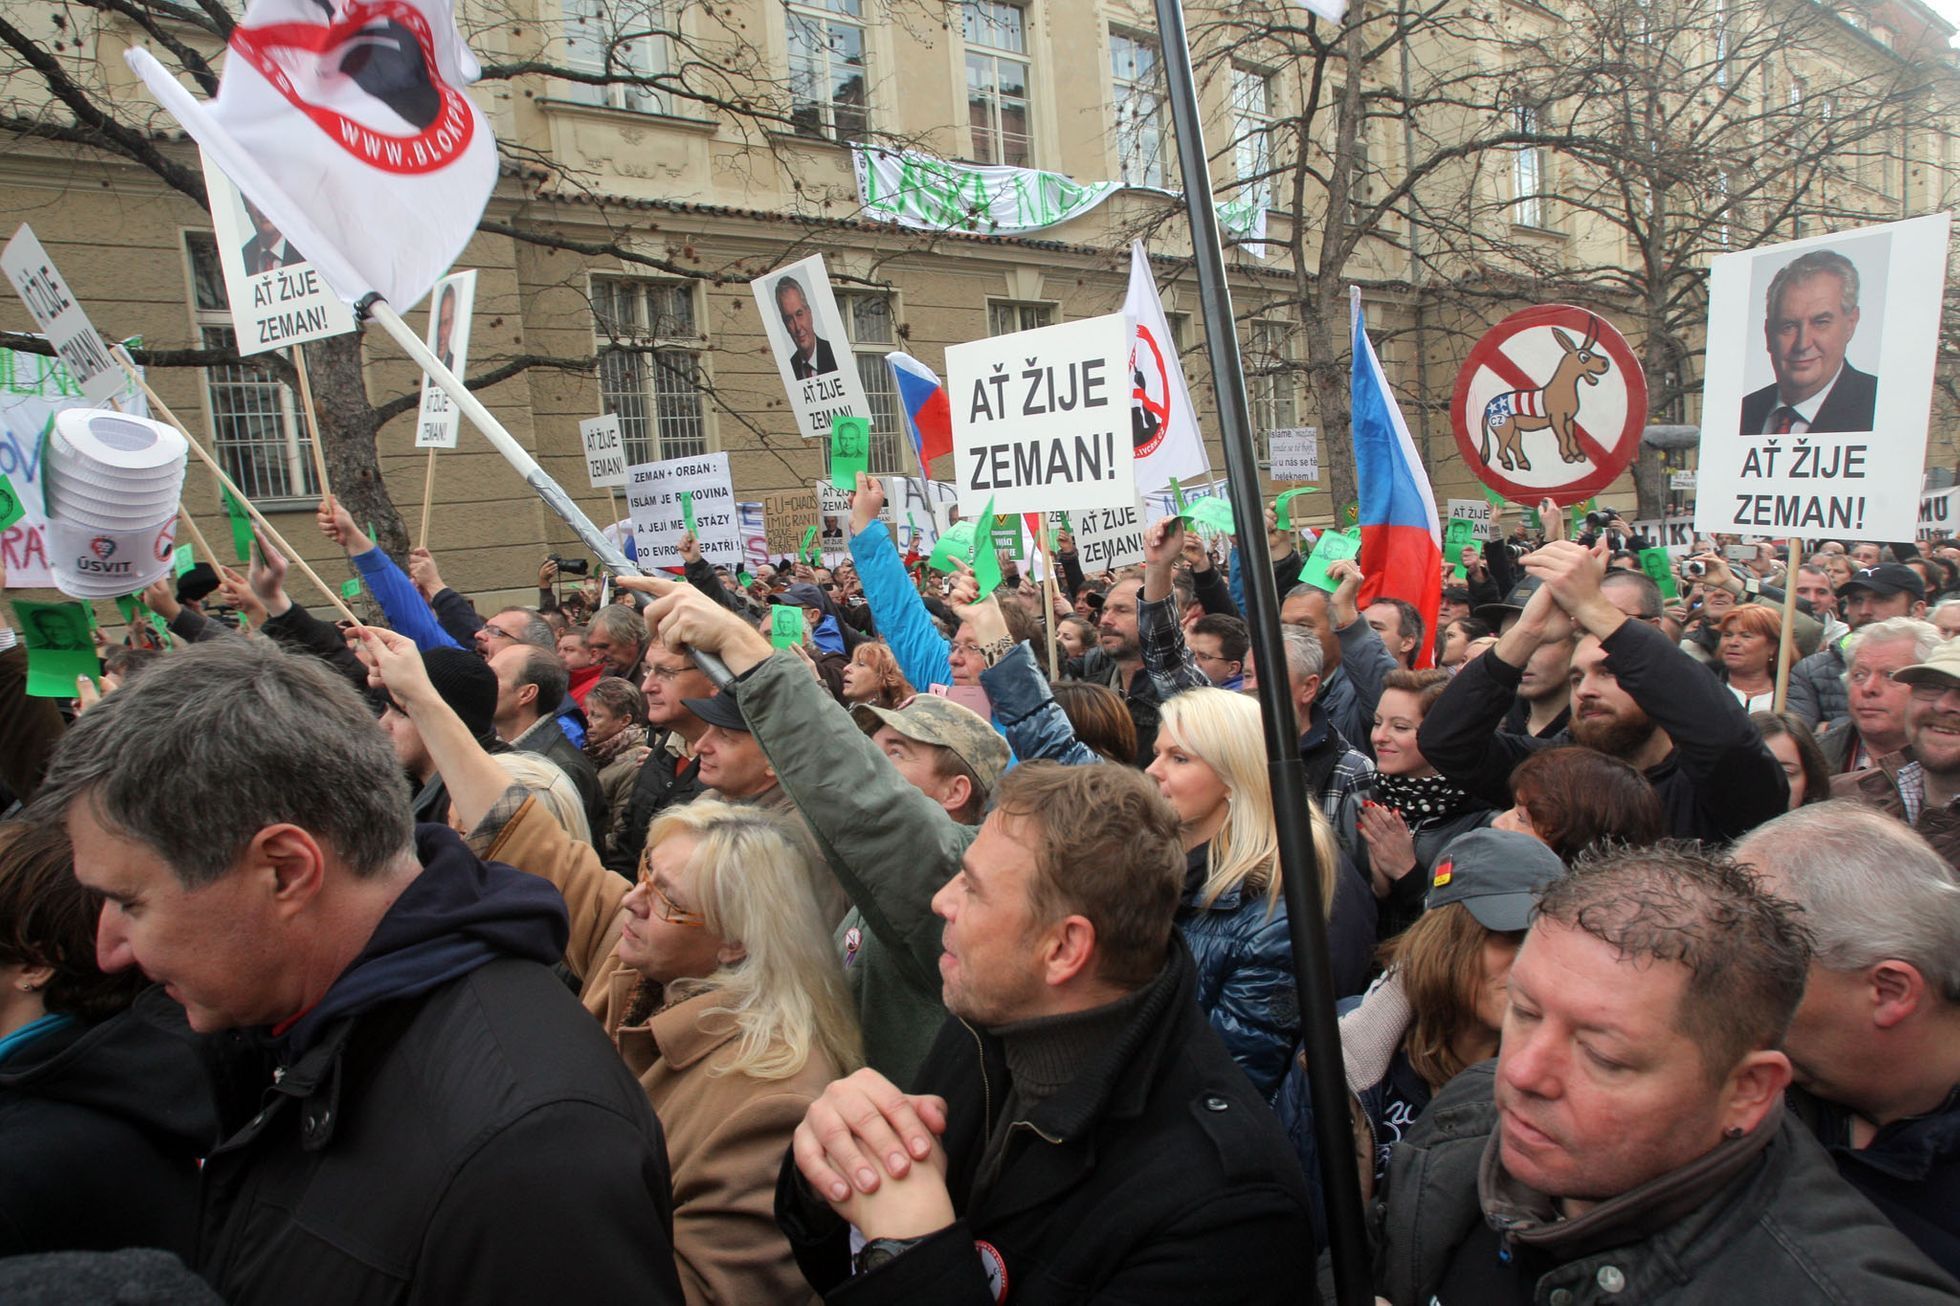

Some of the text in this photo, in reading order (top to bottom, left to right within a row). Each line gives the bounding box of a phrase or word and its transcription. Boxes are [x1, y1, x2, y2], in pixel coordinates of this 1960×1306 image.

[255, 270, 319, 308] AŤ ŽIJE
[257, 305, 328, 343] ZEMAN!
[803, 378, 845, 404] AŤ ŽIJE
[970, 356, 1108, 423] AŤ ŽIJE
[587, 428, 618, 451] AŤ ŽIJE
[590, 456, 625, 477] ZEMAN!
[969, 432, 1115, 490] ZEMAN!
[1740, 437, 1867, 479] AŤ ŽIJE
[634, 469, 665, 483] ZEMAN
[630, 486, 729, 508] ISLÁM JE RKOVINA
[822, 501, 850, 511] ZEMA
[1081, 507, 1137, 536] AŤ ŽIJE
[1453, 504, 1489, 519] AŤ ŽIJE
[1733, 494, 1866, 530] ZEMAN!
[638, 524, 645, 533] A
[638, 547, 650, 557] DO
[653, 545, 680, 556] EVROP
[699, 538, 734, 552] EPATŘÍ
[1083, 532, 1144, 563] ZEMAN!
[77, 556, 132, 573] ÚSVIT
